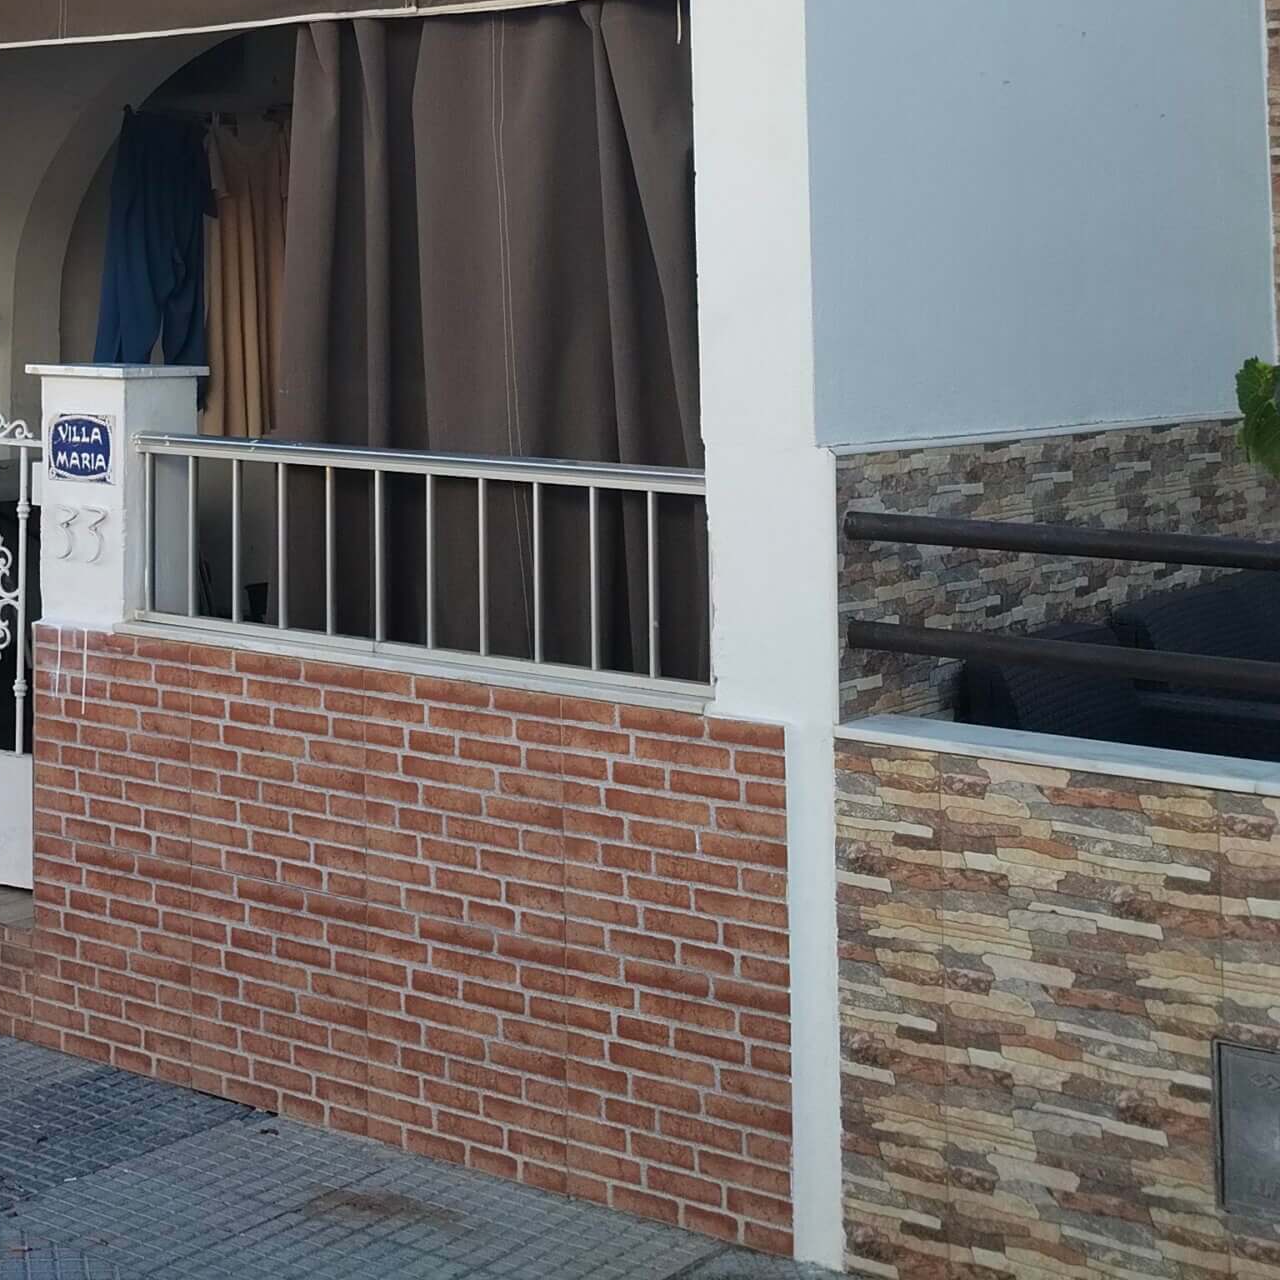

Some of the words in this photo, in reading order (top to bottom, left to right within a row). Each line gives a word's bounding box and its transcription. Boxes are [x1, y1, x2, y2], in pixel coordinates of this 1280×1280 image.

[58, 424, 103, 446] VILLA
[56, 452, 107, 471] MARIA
[57, 505, 108, 563] 33
